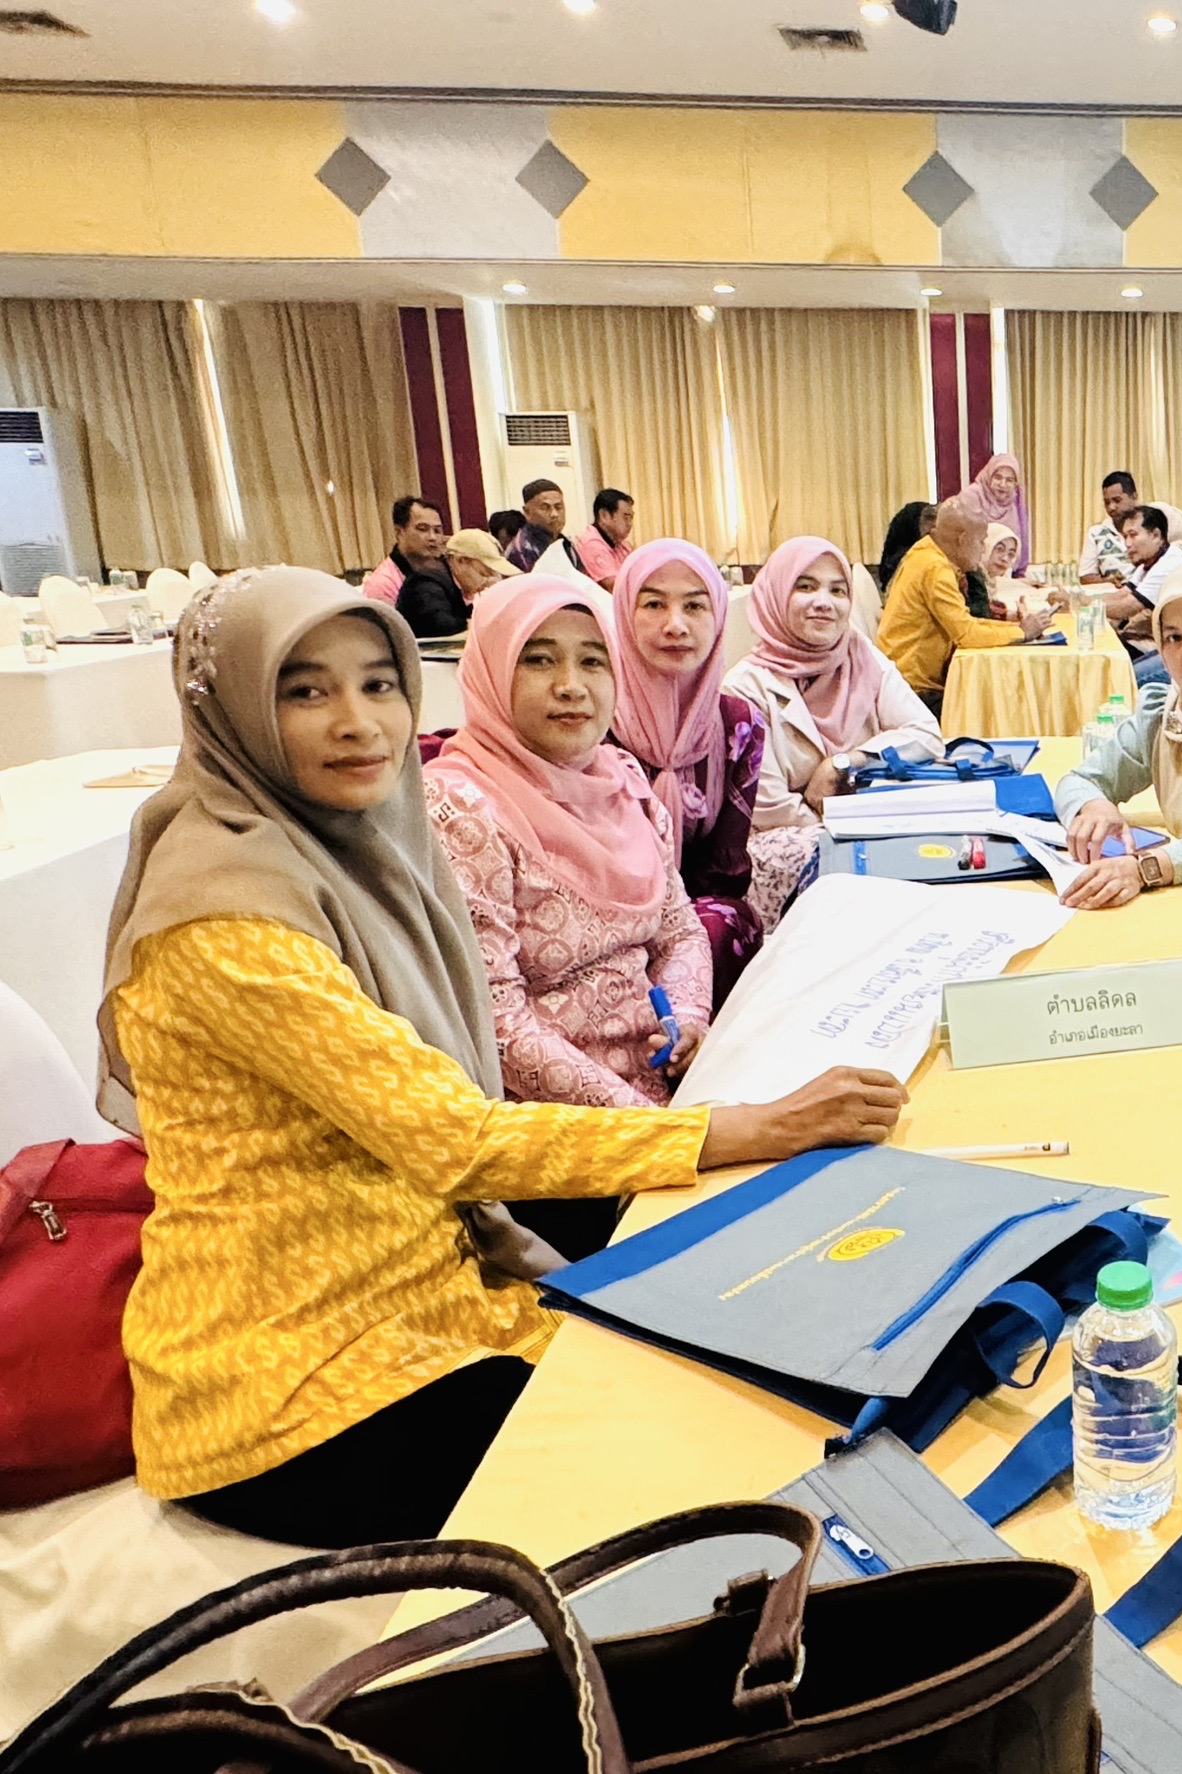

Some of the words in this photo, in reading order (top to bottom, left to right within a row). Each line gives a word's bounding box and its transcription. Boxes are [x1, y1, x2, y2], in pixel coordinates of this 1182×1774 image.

[1046, 989, 1138, 1015] ตำบลลิดล
[1048, 1023, 1144, 1045] อำเภอเมืองยะลา
